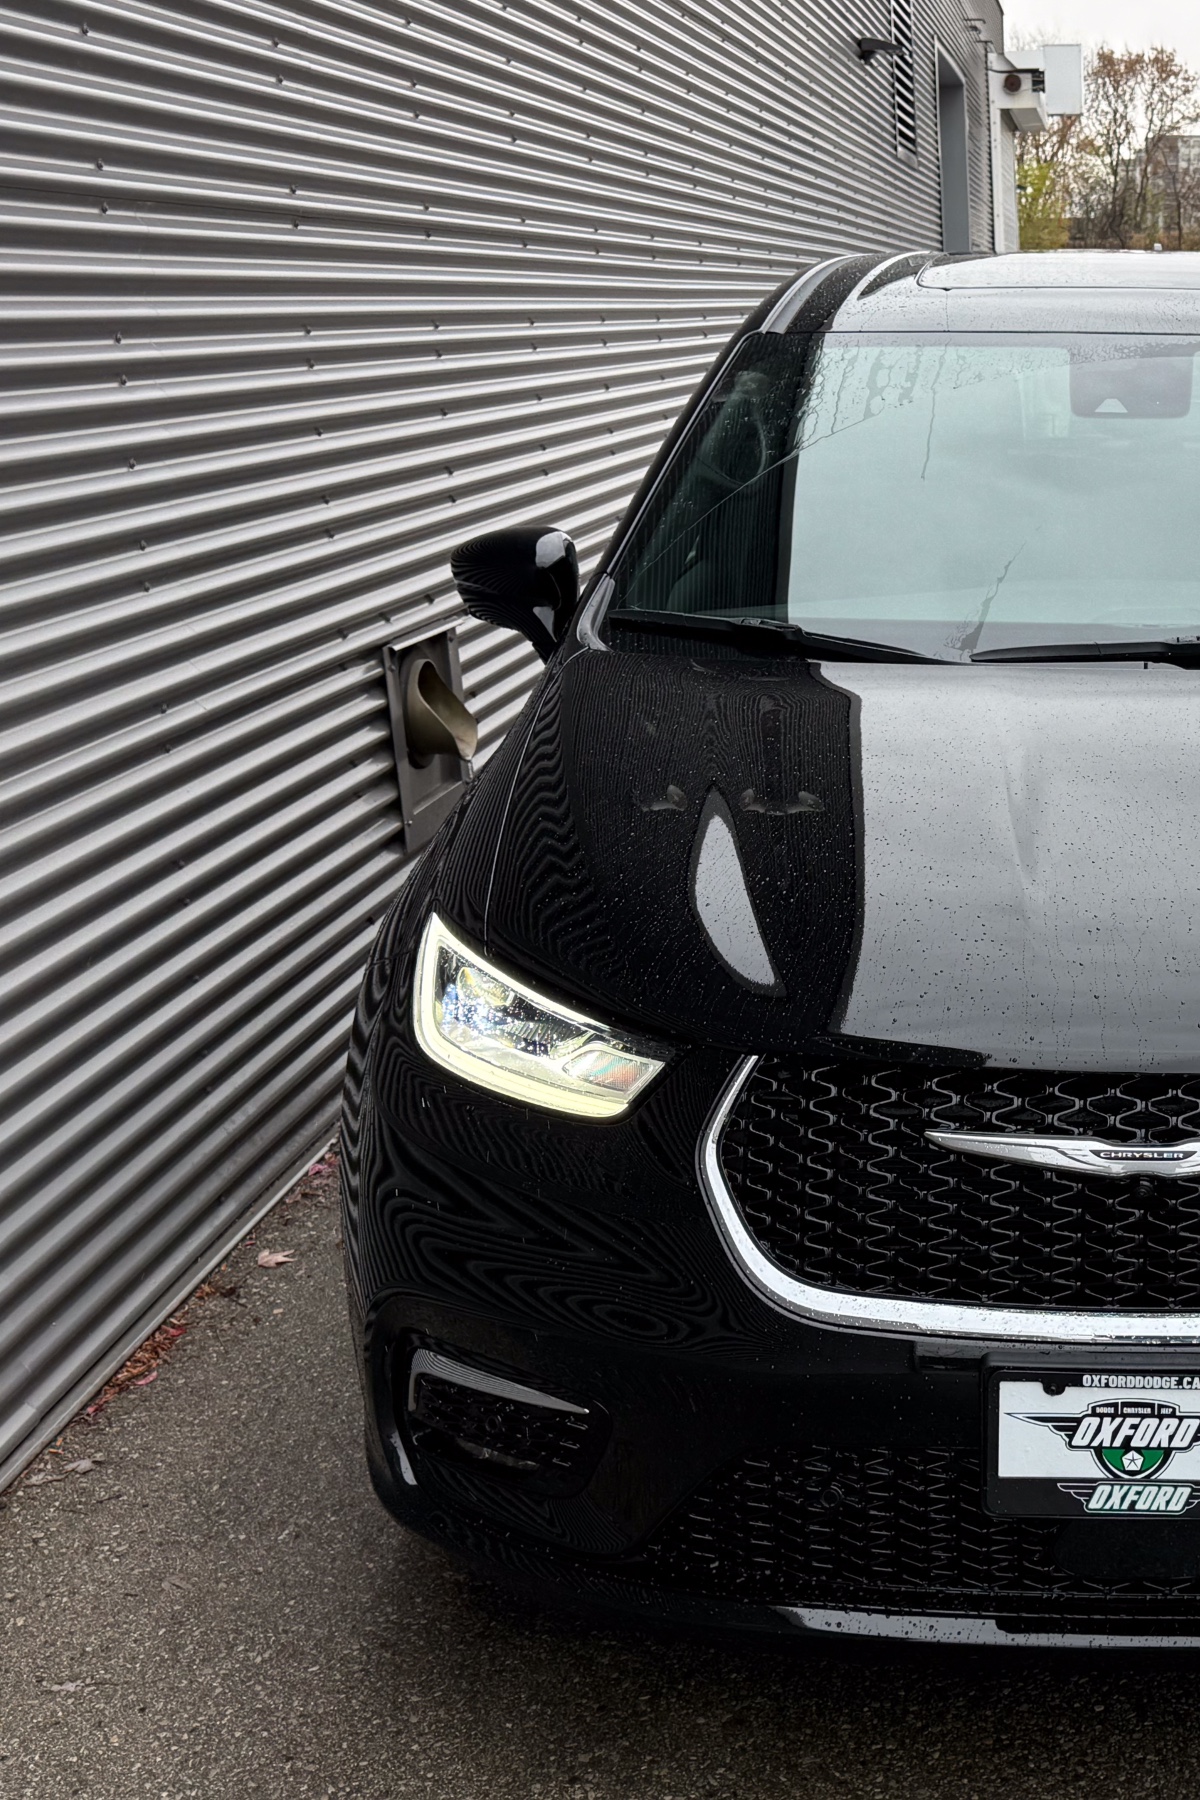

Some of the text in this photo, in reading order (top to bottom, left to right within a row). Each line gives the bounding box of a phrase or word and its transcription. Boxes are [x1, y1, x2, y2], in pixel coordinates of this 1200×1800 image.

[1100, 1151, 1184, 1159] CHRYSLER
[1095, 1406, 1115, 1414] DODGE
[1088, 1484, 1192, 1512] OXFORD
